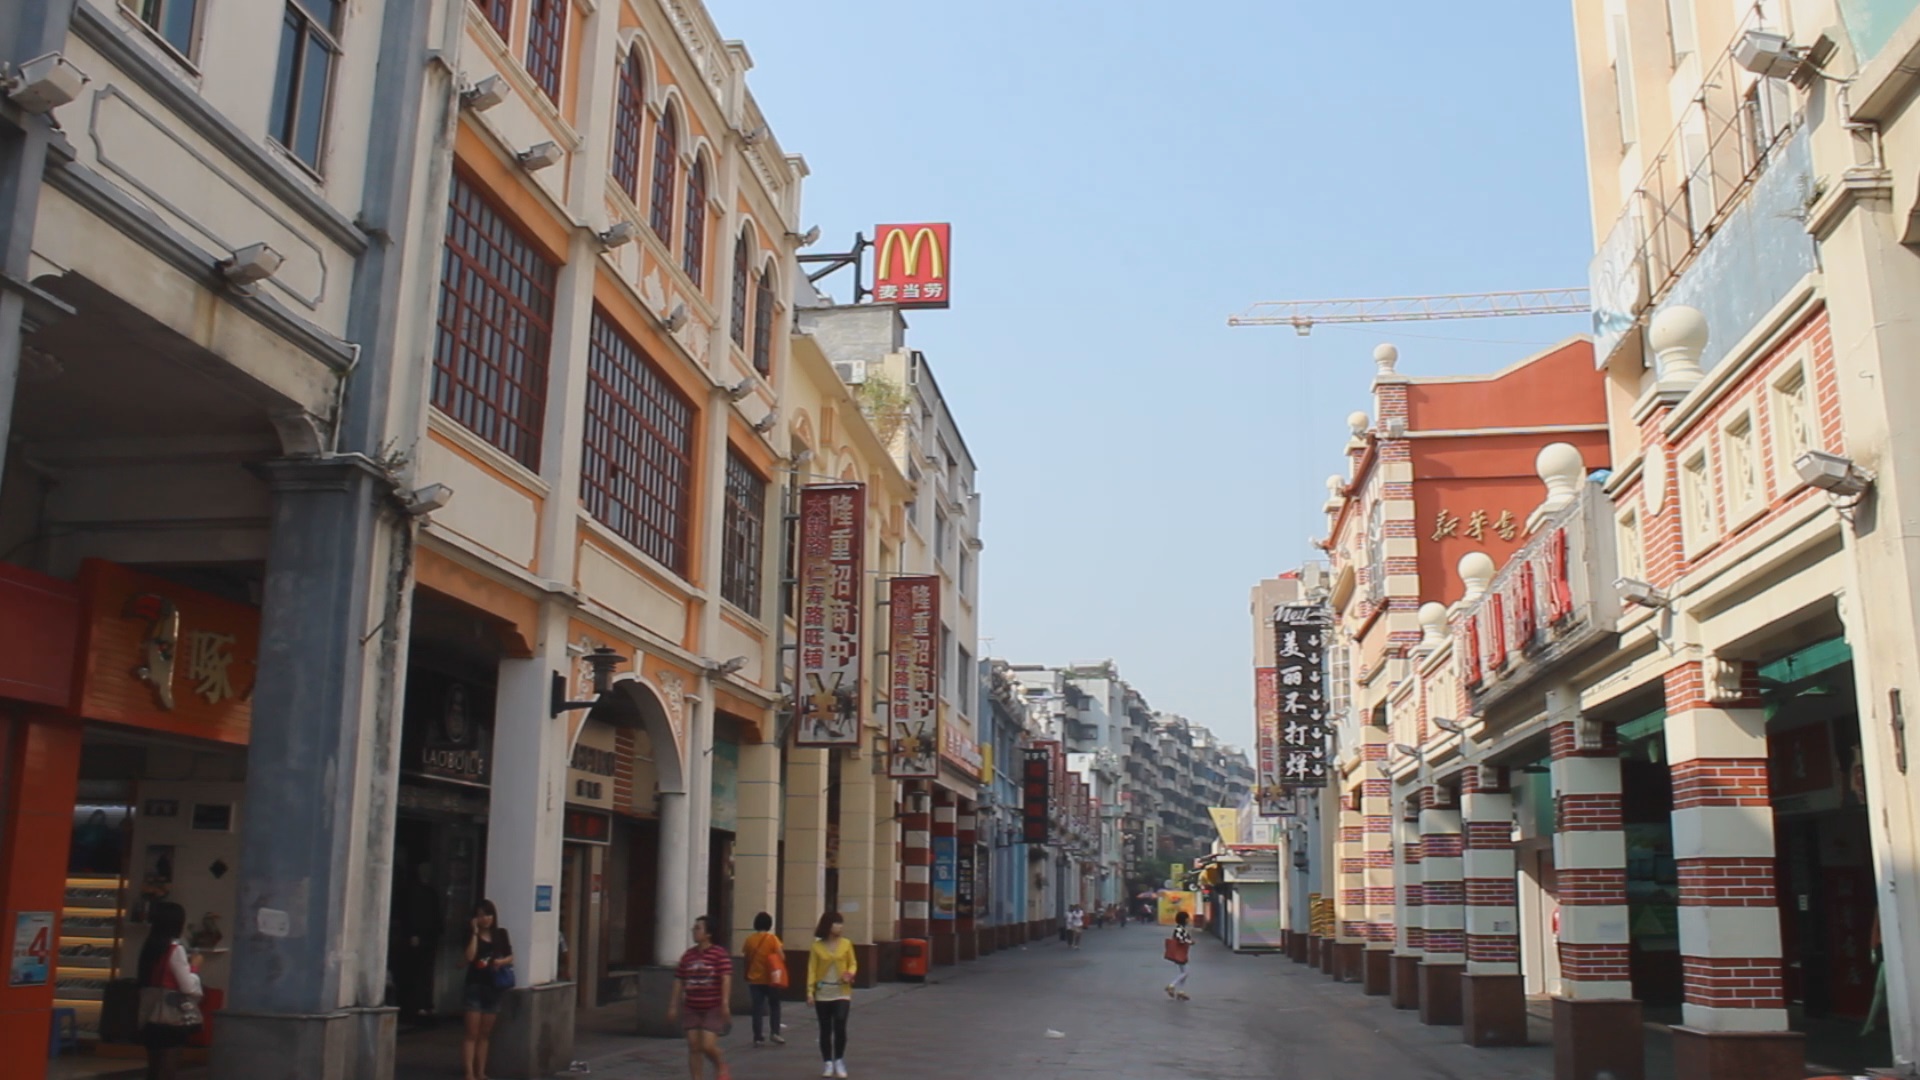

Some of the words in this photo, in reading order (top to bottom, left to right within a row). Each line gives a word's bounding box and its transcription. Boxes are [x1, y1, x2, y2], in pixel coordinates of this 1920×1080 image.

[878, 283, 943, 299] 麦当劳
[828, 493, 854, 668] 隆重招商中
[911, 584, 932, 718] 隆重招商中
[1279, 630, 1310, 781] 美丽不打烊
[28, 926, 49, 965] 4
